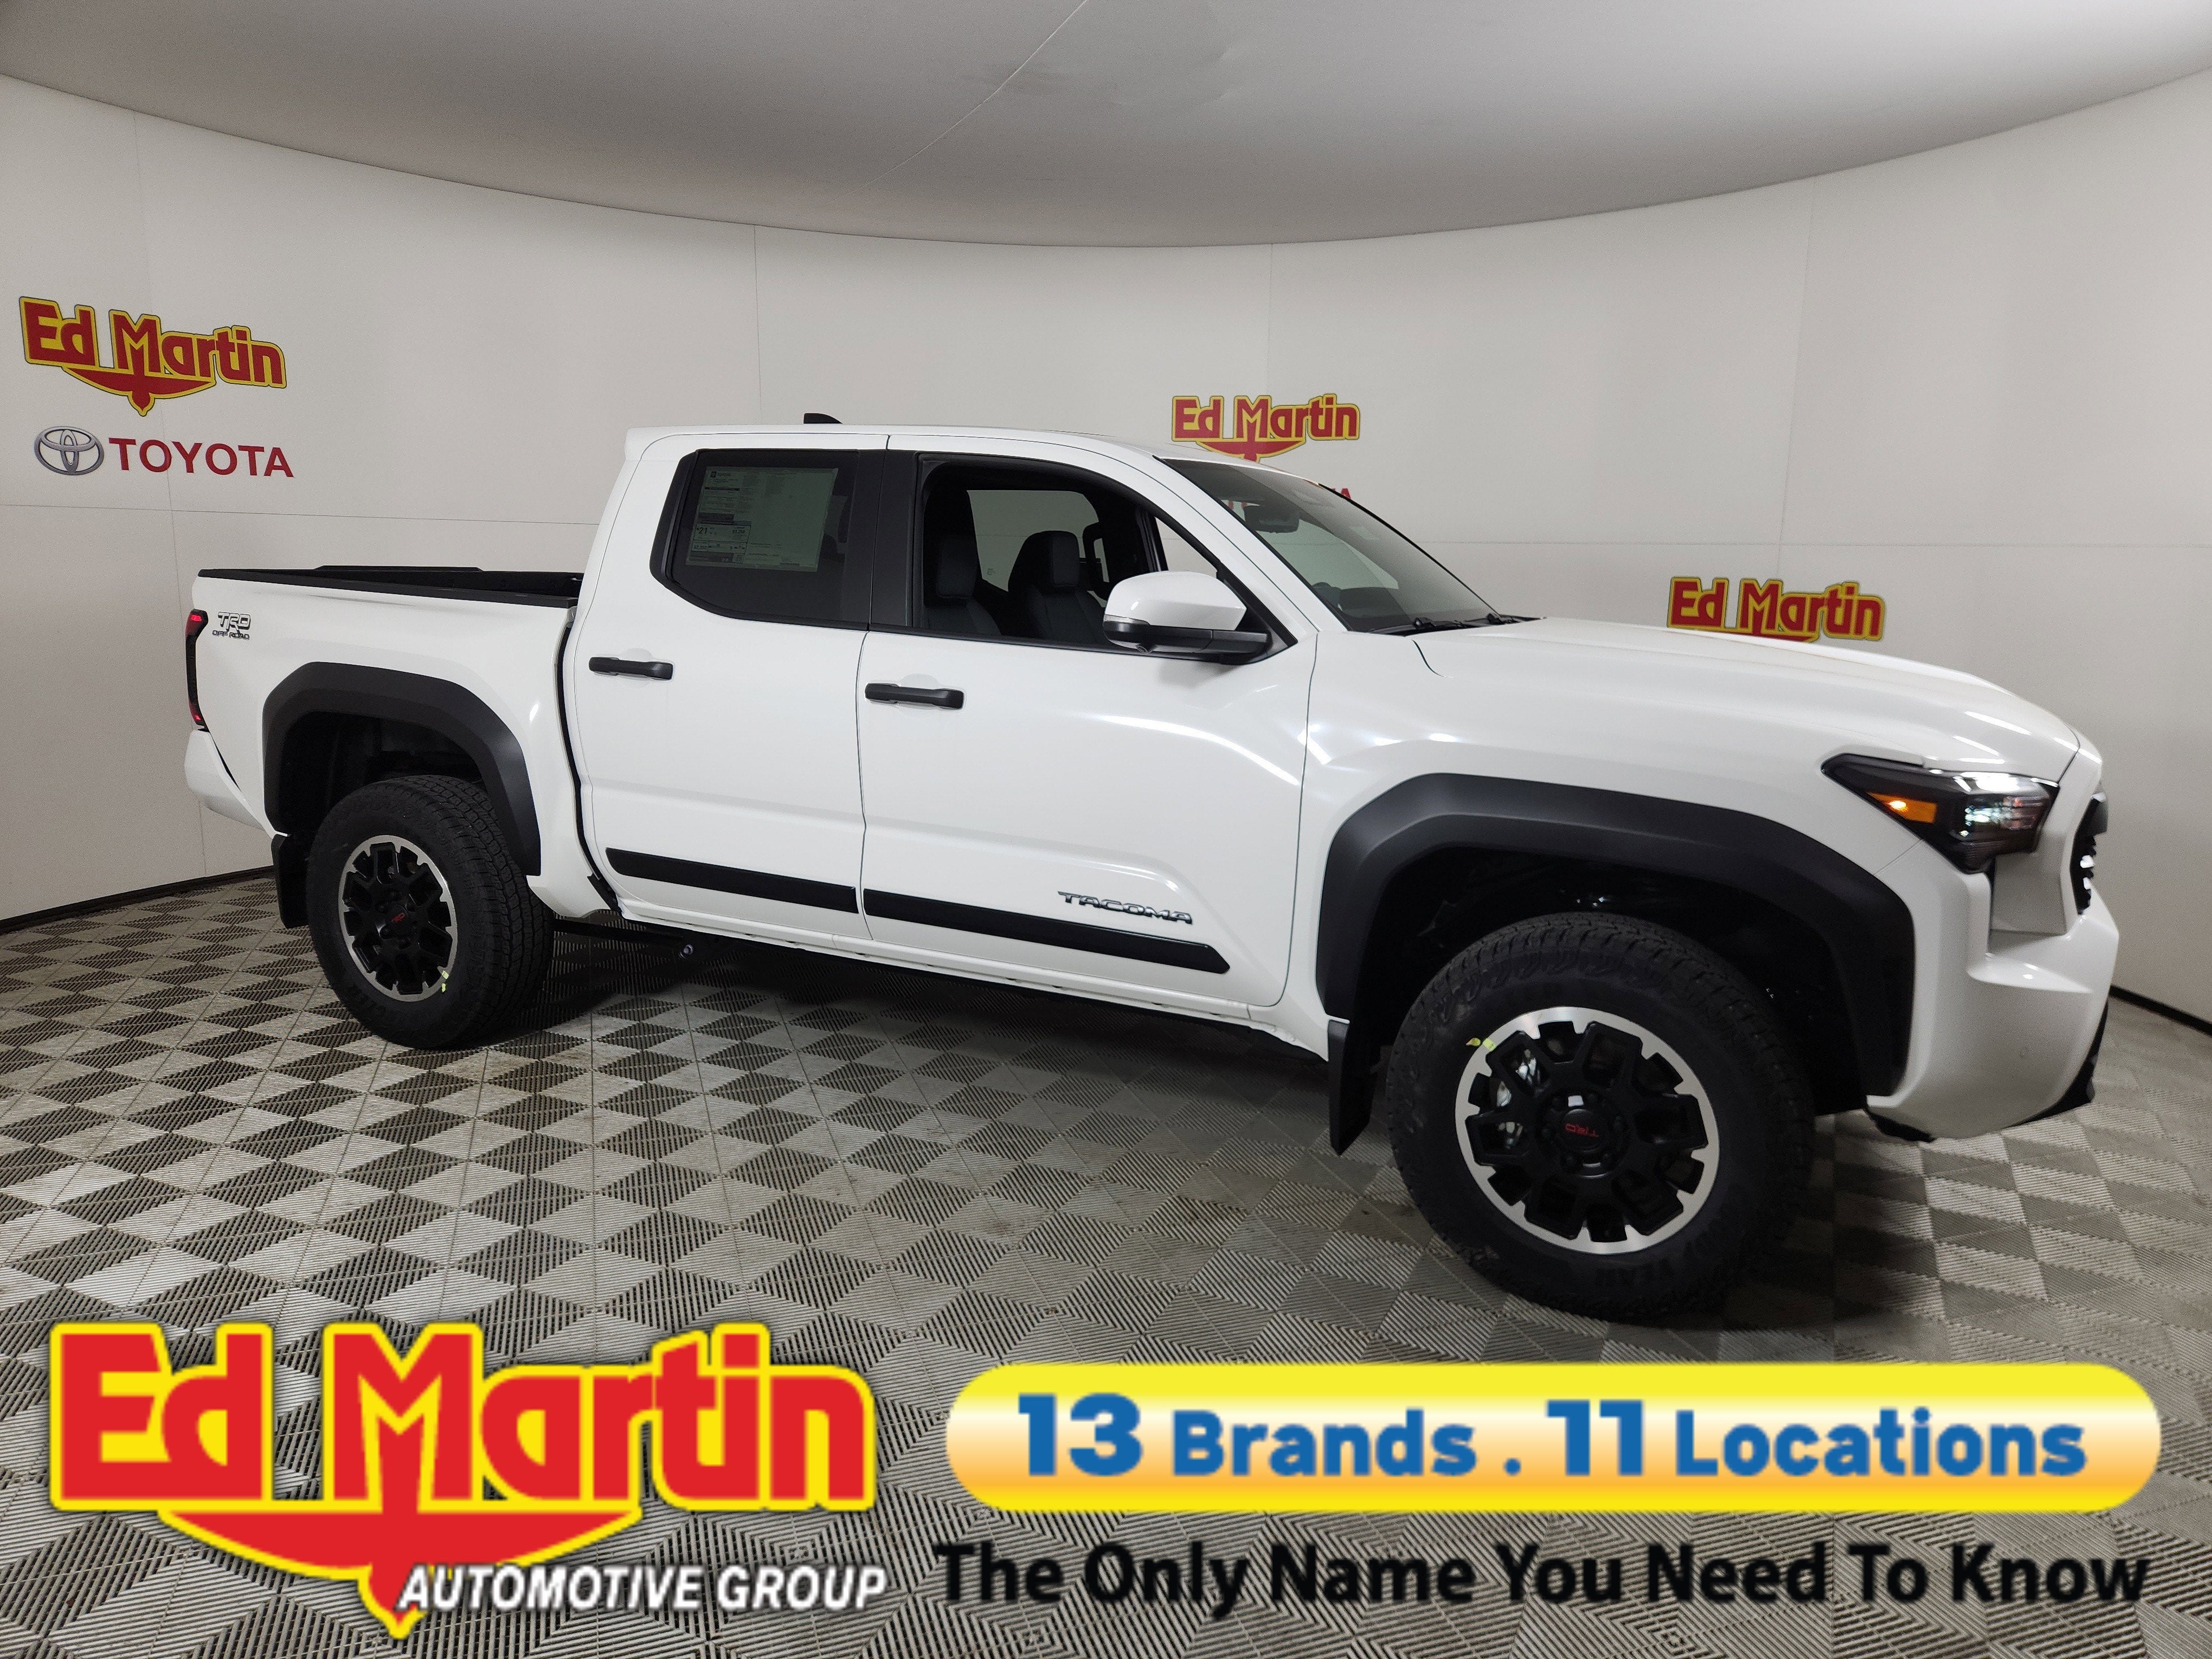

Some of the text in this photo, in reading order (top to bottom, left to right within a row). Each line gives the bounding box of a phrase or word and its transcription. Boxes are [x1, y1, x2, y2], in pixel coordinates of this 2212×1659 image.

[20, 297, 286, 388] Ed Martin
[1173, 394, 1360, 441] Ed Martin
[108, 437, 294, 478] TOYOTA
[218, 612, 251, 633] TRD
[1668, 577, 1885, 641] Ed Martin
[229, 632, 250, 640] ROAD
[1057, 891, 1193, 925] TACOMA
